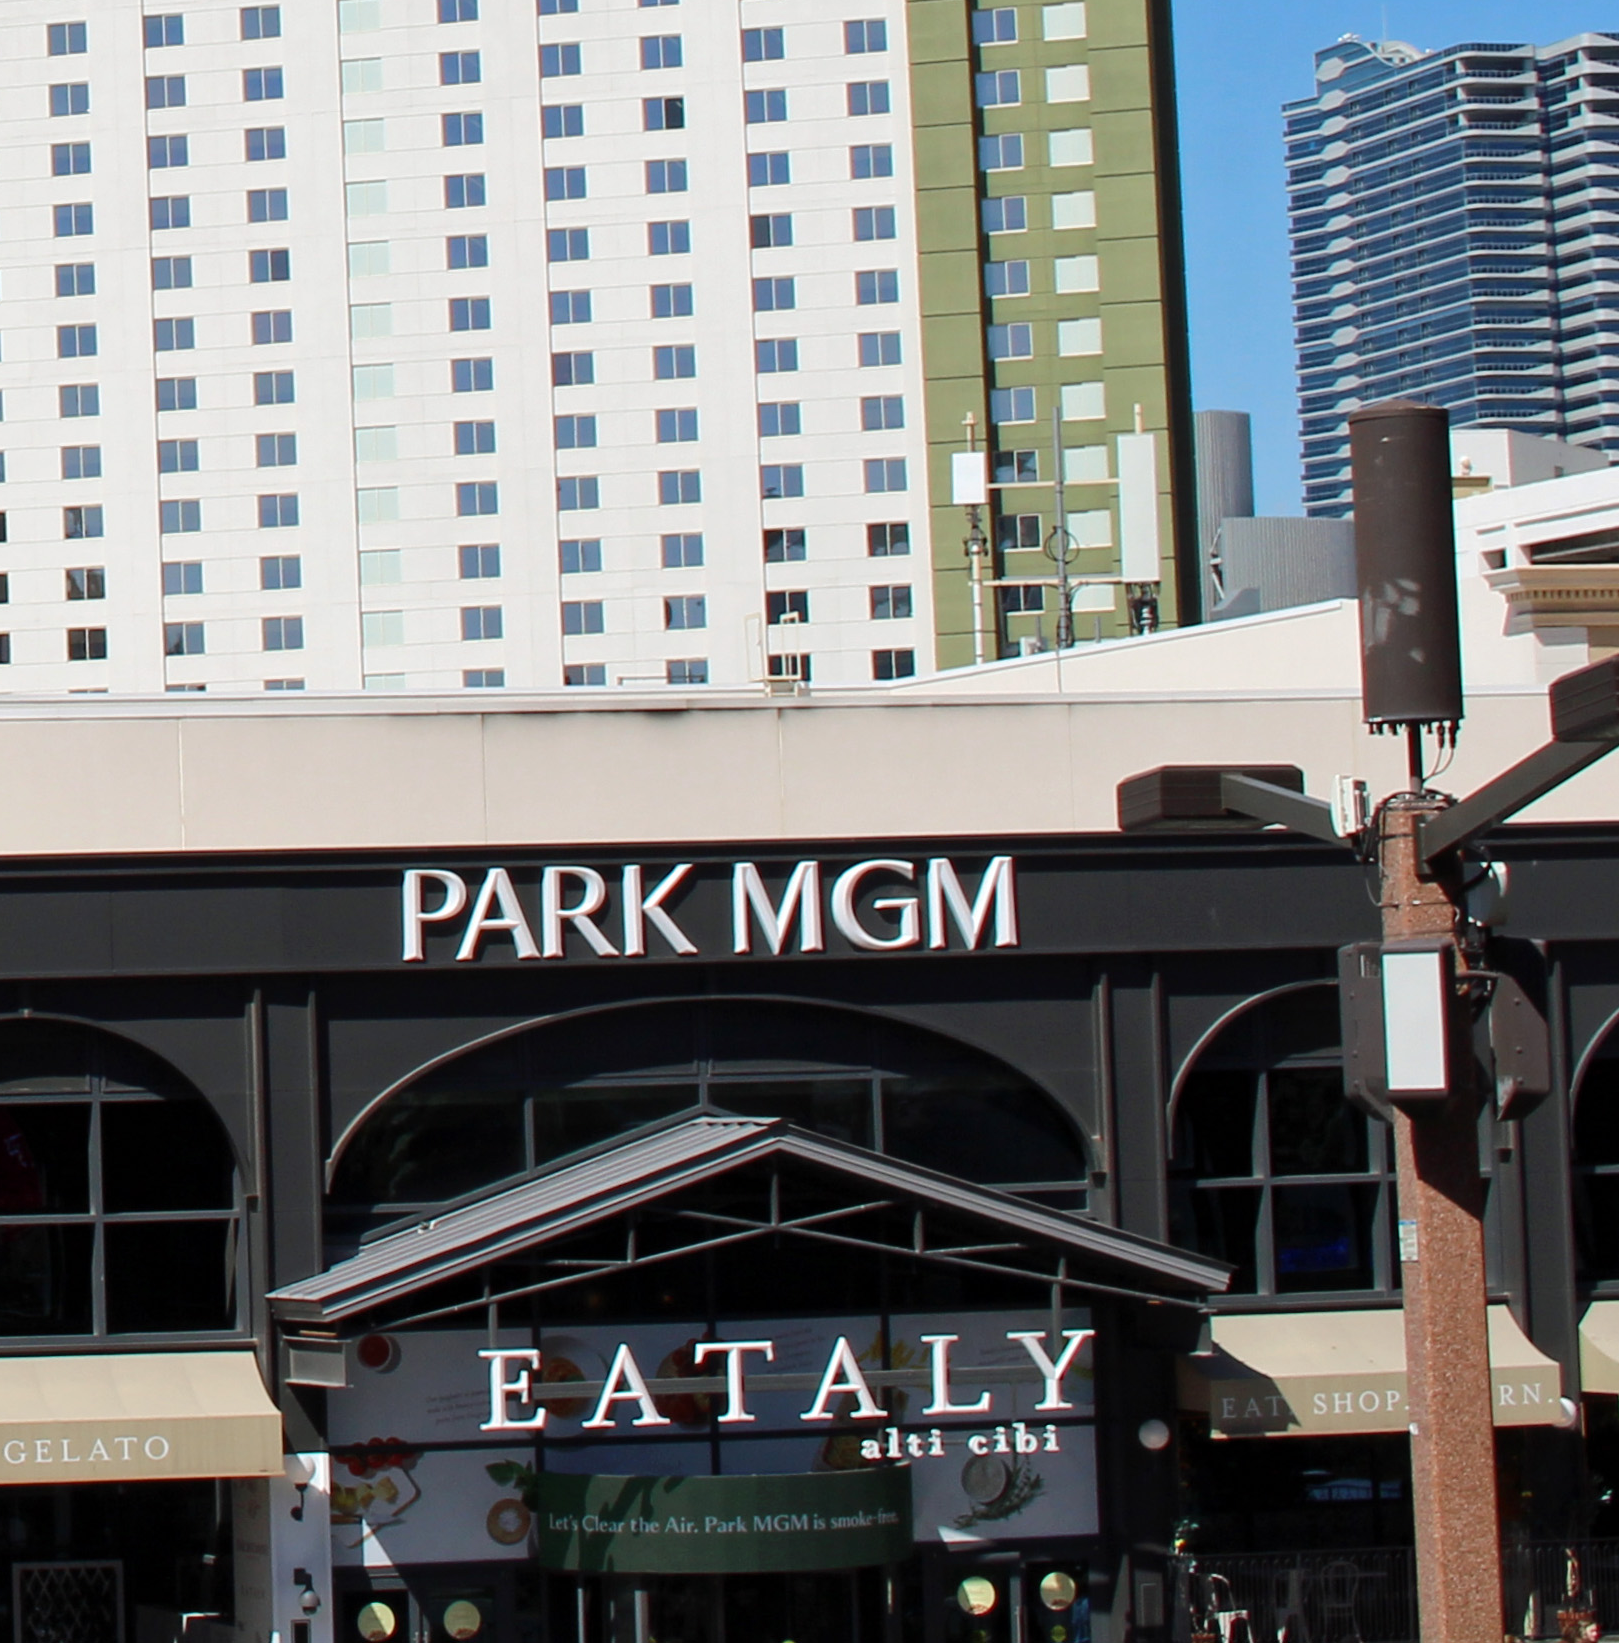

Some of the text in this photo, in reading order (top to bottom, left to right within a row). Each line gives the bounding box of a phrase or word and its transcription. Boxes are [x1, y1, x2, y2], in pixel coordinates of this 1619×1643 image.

[402, 856, 1020, 963] PARK MGM
[478, 1329, 1097, 1431] EATALY
[1313, 1390, 1410, 1416] SHOP.
[3, 1434, 171, 1464] GELATO
[859, 1422, 1061, 1460] alti cibi
[582, 1514, 626, 1533] Clear
[630, 1515, 661, 1533] the
[664, 1515, 699, 1534] Air.
[704, 1514, 748, 1534] Park
[752, 1514, 810, 1533] MGM
[813, 1513, 827, 1531] is
